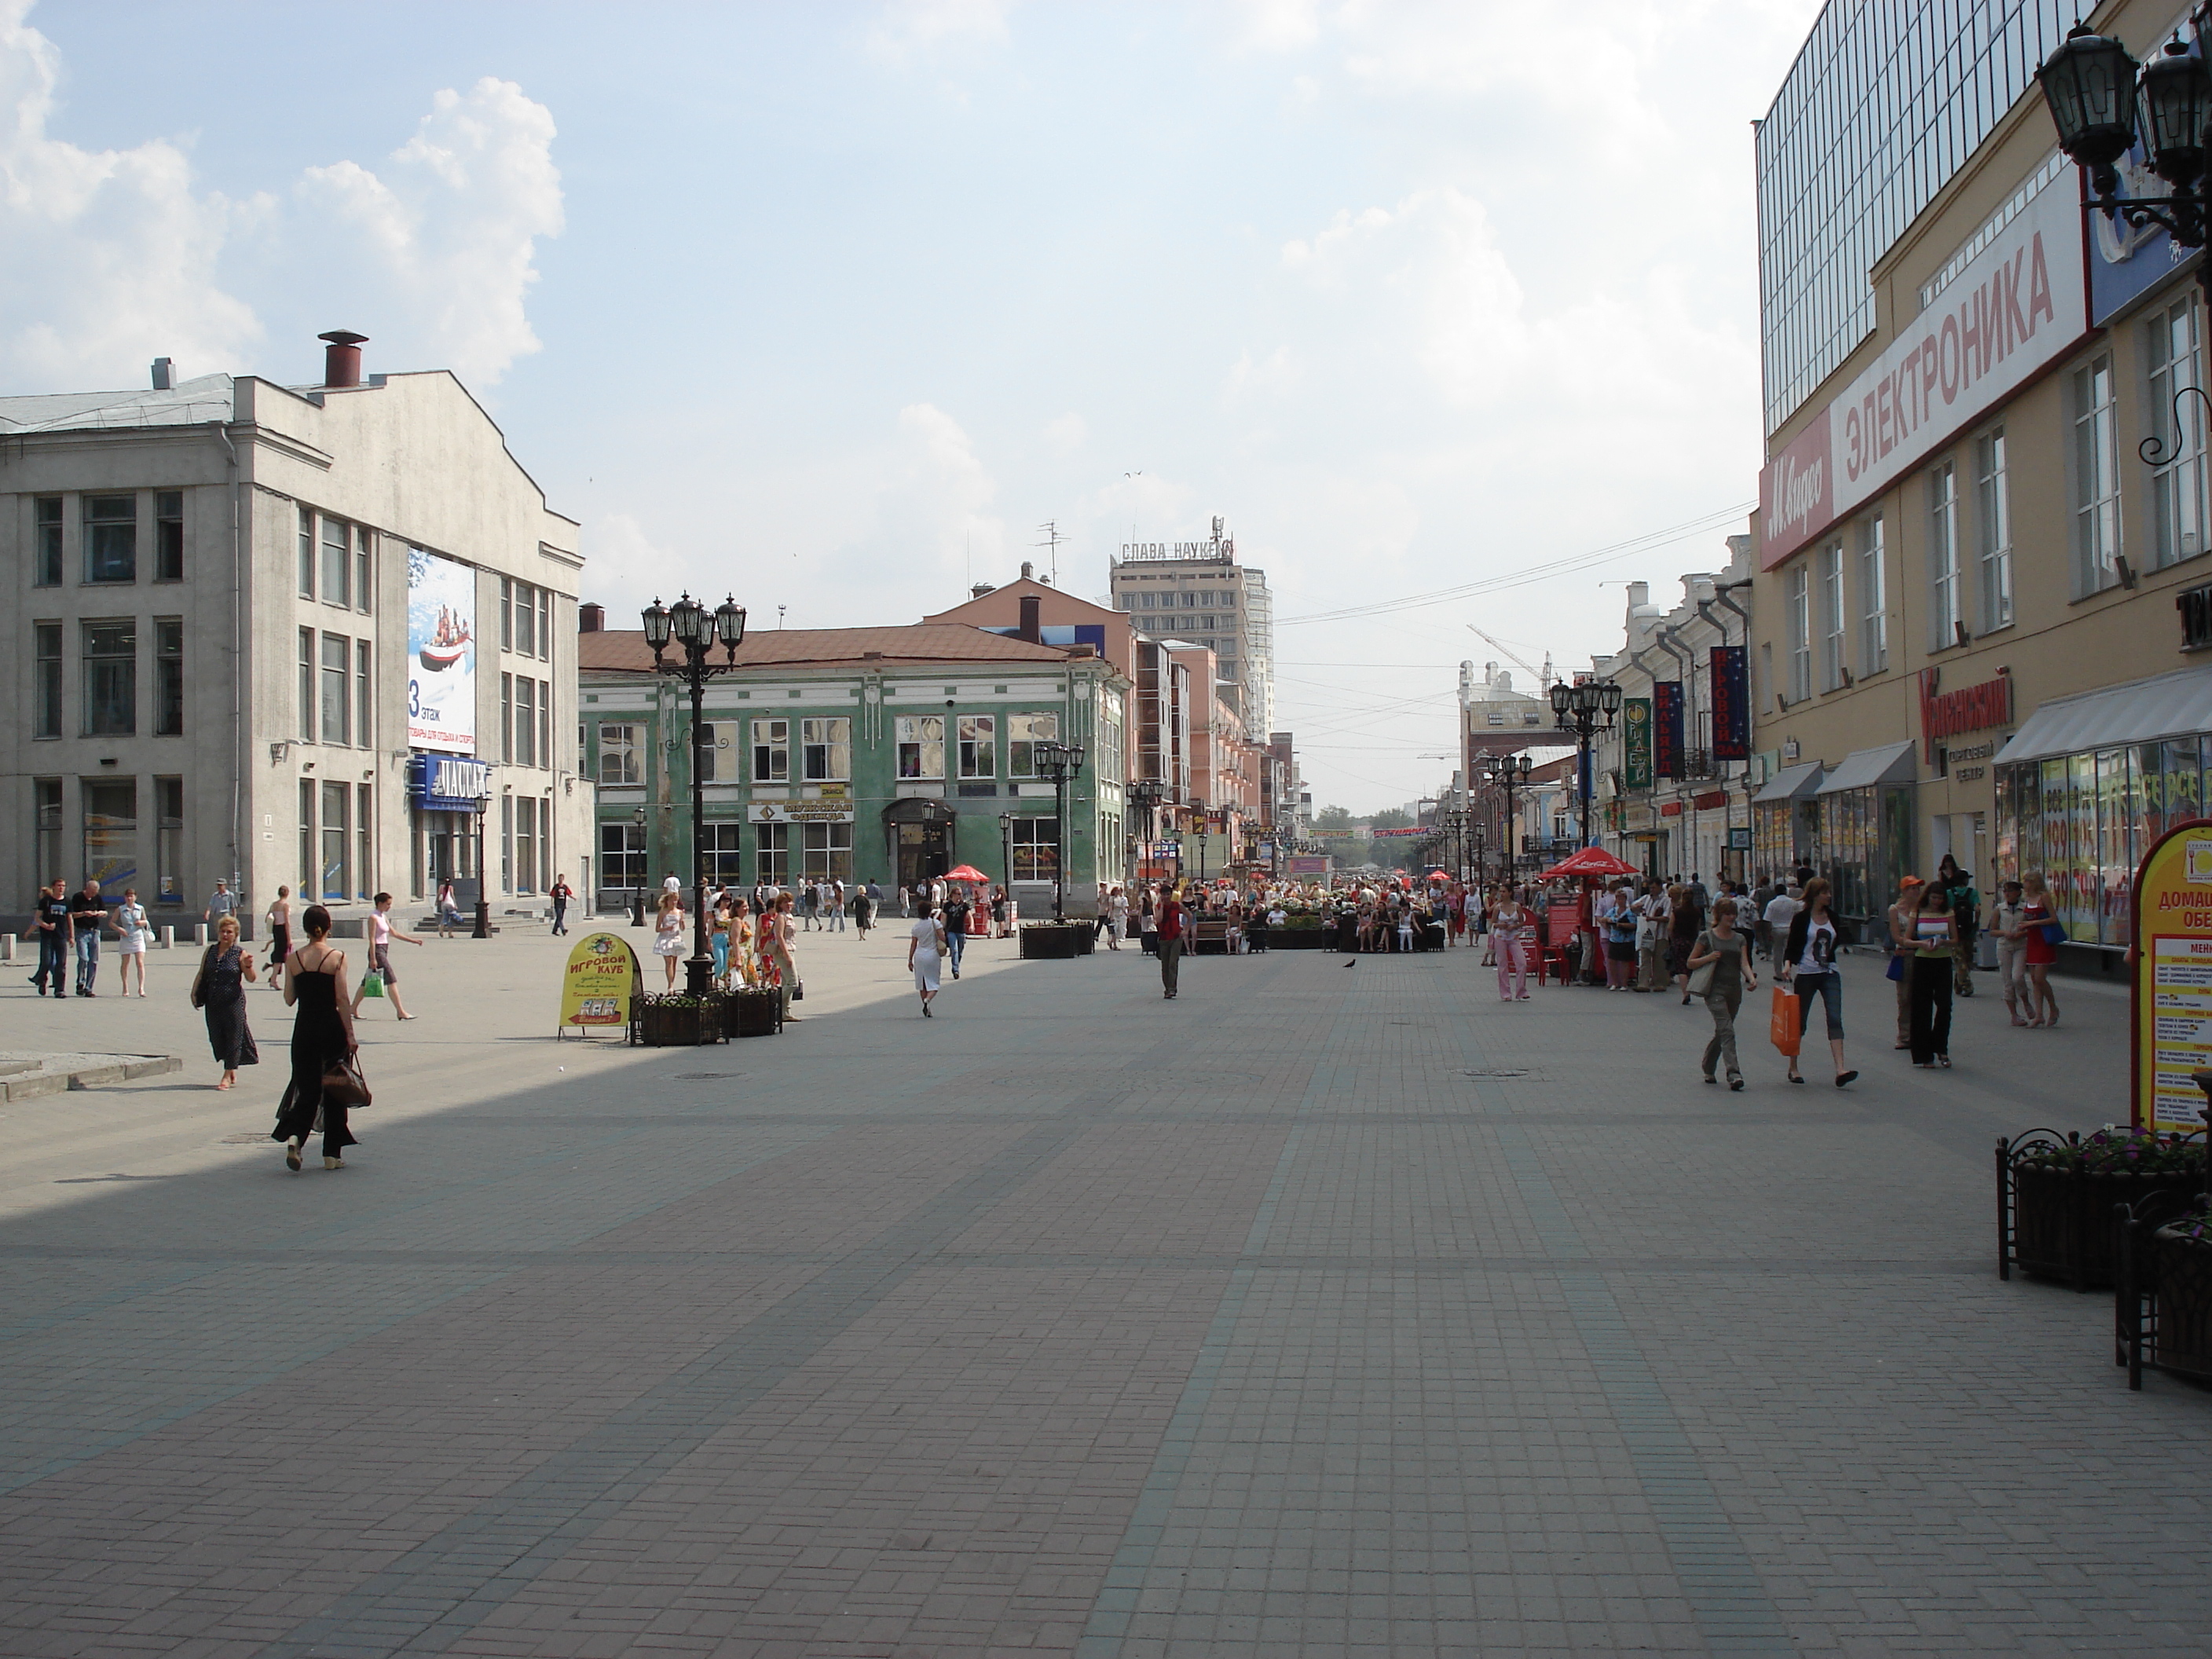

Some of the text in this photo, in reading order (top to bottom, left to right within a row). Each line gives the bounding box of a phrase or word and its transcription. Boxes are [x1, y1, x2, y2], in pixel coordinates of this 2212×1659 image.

[1846, 230, 2054, 482] ЭЛЕКТРОНИКА
[1122, 541, 1217, 560] СЛАВА НАУКЕ
[408, 679, 441, 722] 3 этаж
[1714, 650, 1730, 742] ИГРОВОЙ
[1658, 685, 1672, 775] БИЛЬЯРД
[1716, 745, 1745, 756] ЗАЛ
[1956, 766, 1984, 783] ЦЕНТР
[790, 813, 846, 822] ОДЕЖДА
[2184, 911, 2212, 928] ОБЕ
[2191, 943, 2212, 954] МЕН
[569, 955, 627, 974] ИГРОВОЙ
[598, 965, 624, 974] КЛУБ
